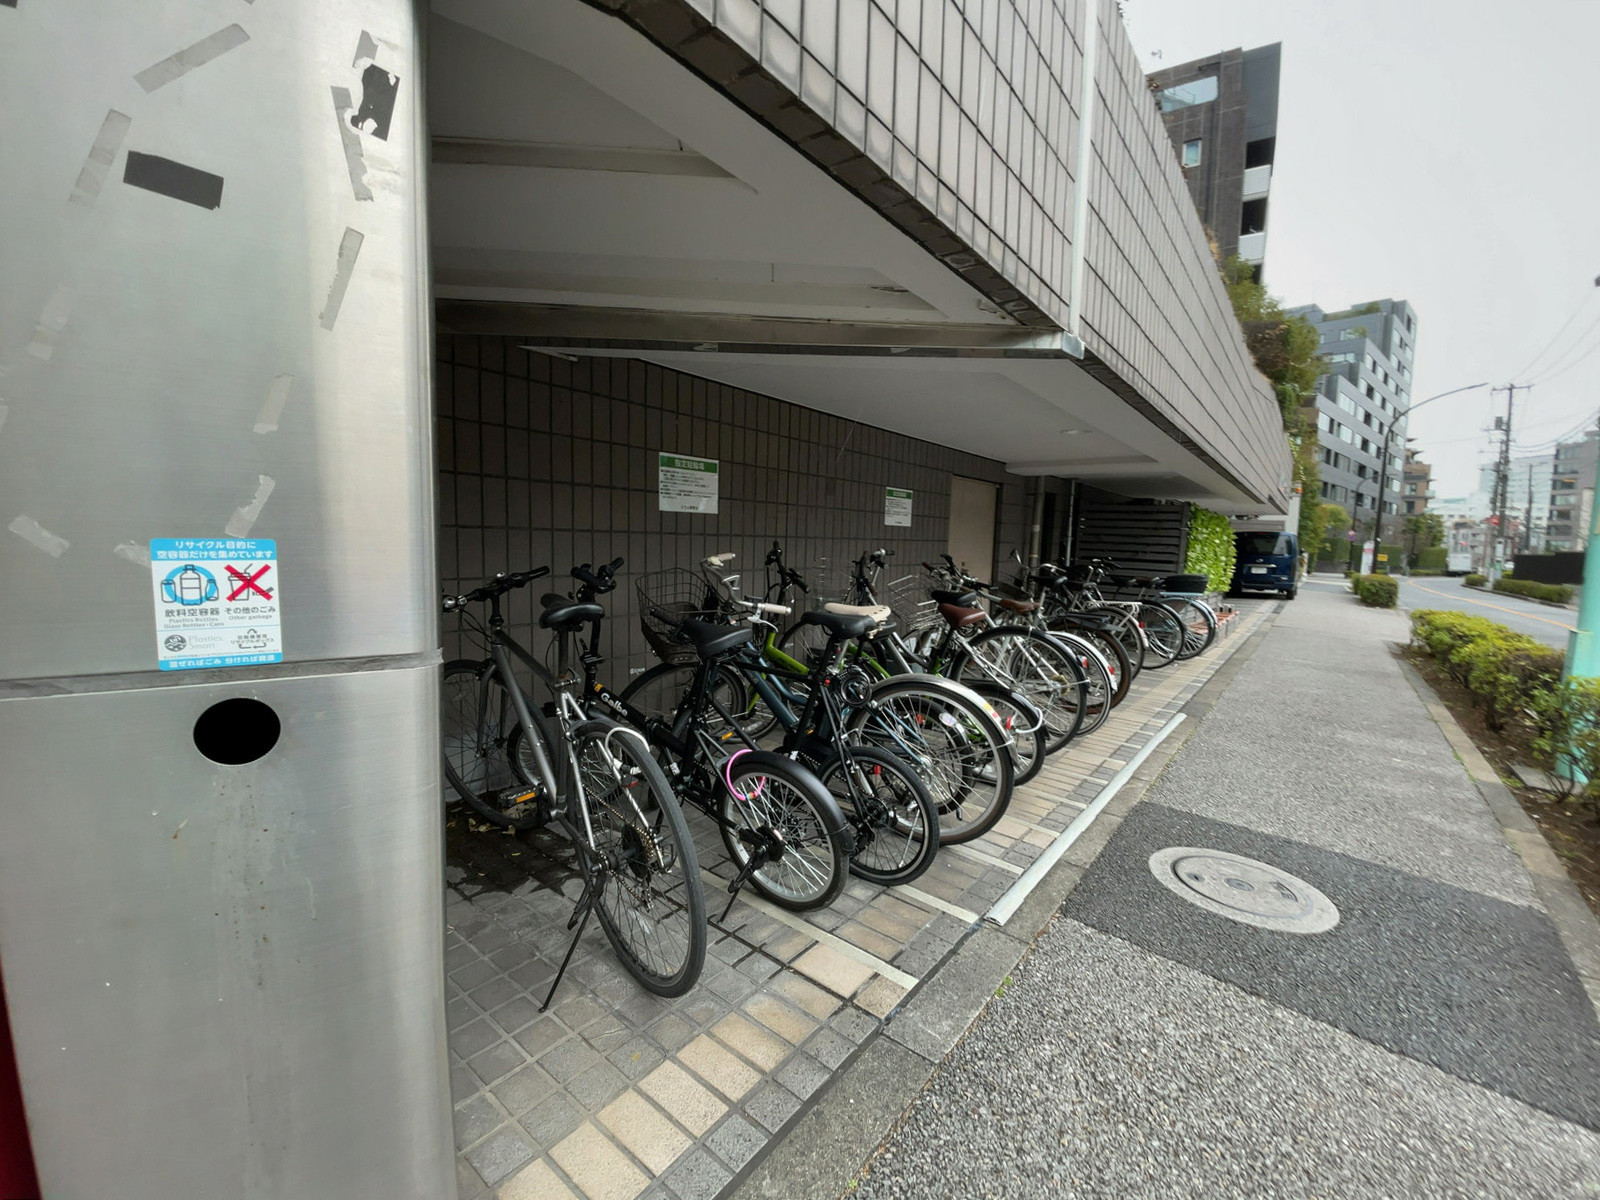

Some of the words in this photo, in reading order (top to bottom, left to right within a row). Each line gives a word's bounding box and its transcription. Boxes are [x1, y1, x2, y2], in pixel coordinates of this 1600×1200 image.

[175, 540, 257, 549] リサイクル目的に
[156, 550, 273, 560] 空容器だけを集めています
[224, 605, 276, 615] その他のごみ
